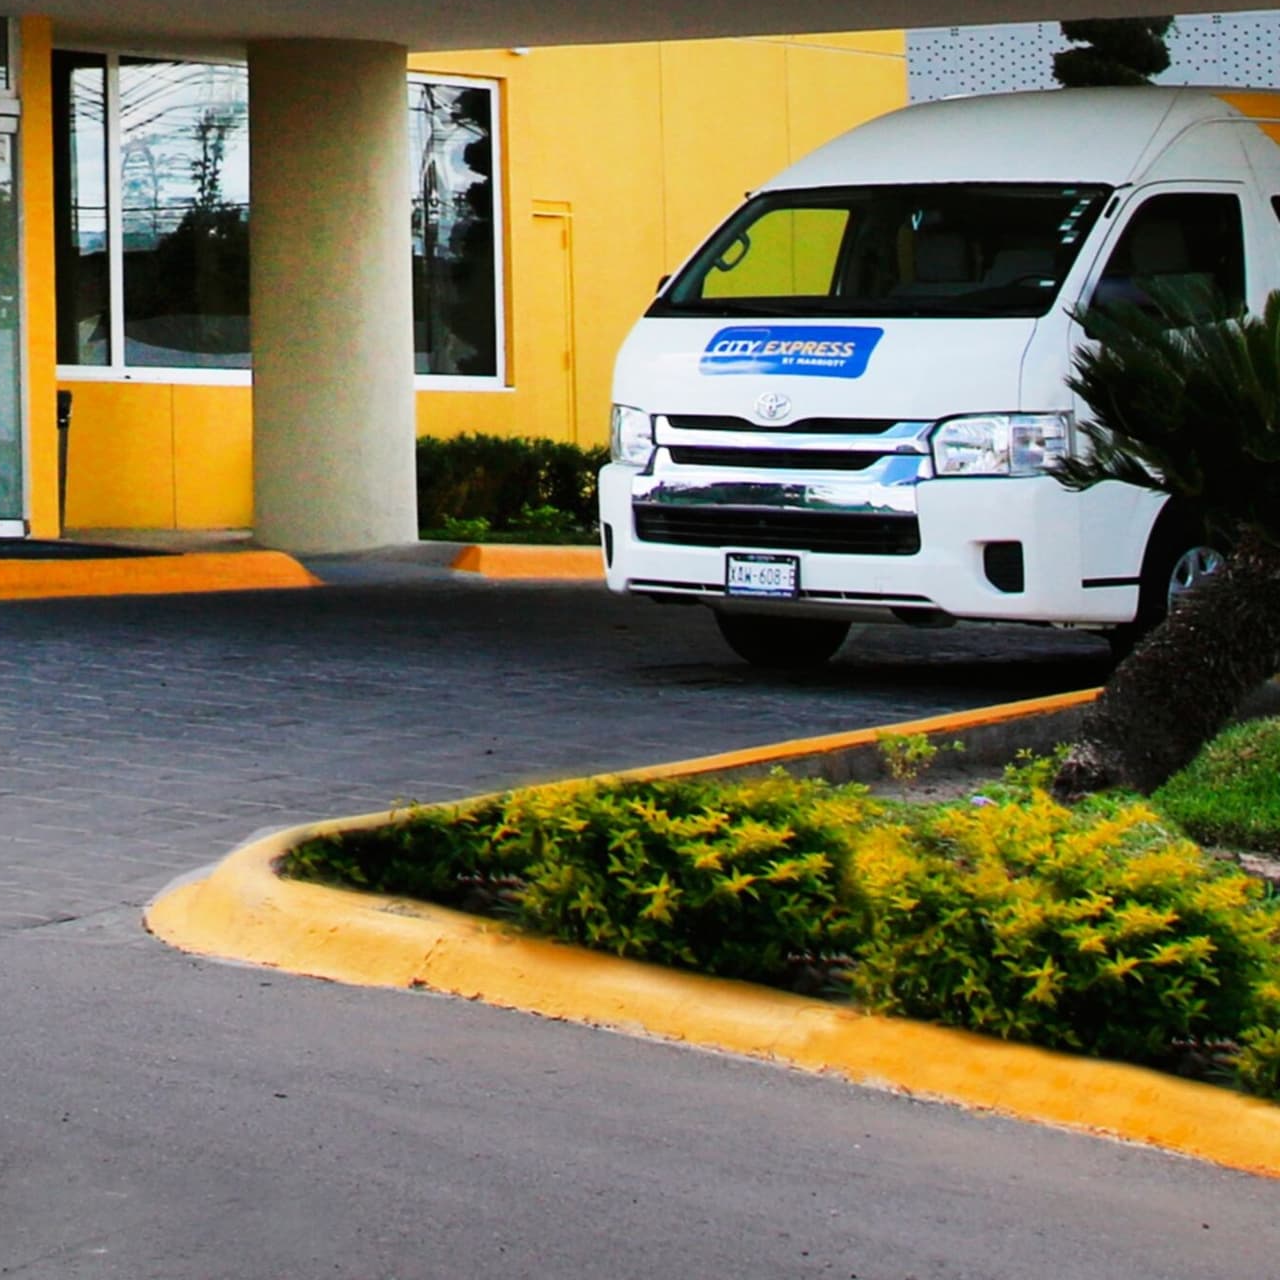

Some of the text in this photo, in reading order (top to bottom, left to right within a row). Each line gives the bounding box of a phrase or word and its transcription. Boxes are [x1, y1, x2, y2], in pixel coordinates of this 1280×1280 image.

[713, 340, 857, 358] CITY EXPRESS
[796, 357, 847, 368] MARRIOTT
